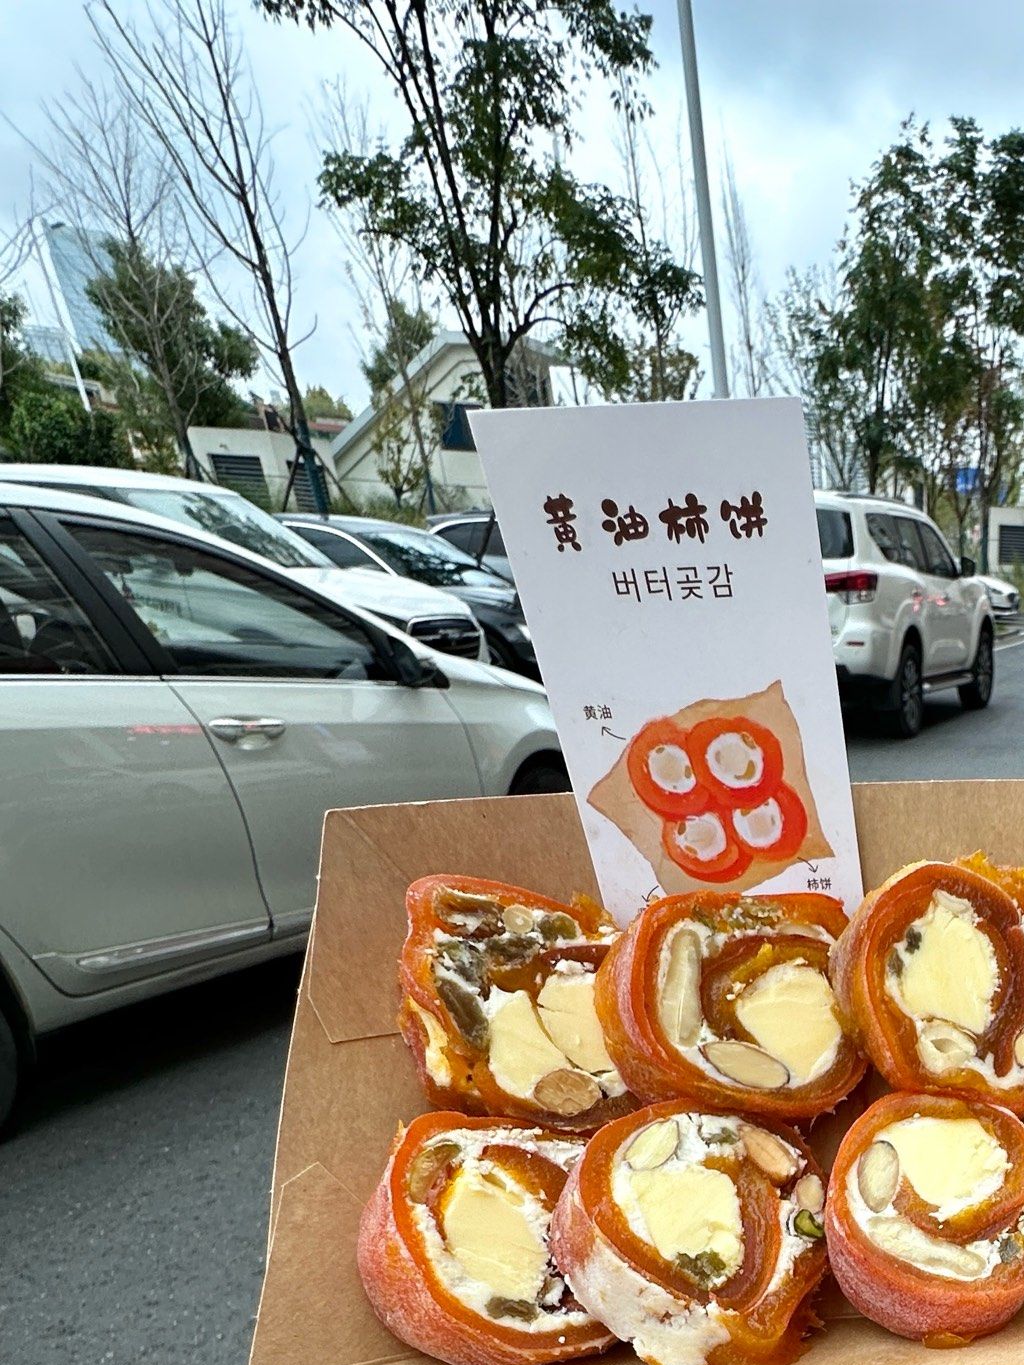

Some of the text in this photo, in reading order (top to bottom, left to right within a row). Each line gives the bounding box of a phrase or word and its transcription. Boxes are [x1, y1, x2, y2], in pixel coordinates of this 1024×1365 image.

[543, 490, 768, 553] 黄油柿饼
[611, 563, 734, 603] 버터곶감
[582, 703, 613, 721] 黄油
[806, 877, 833, 891] 柿饼
